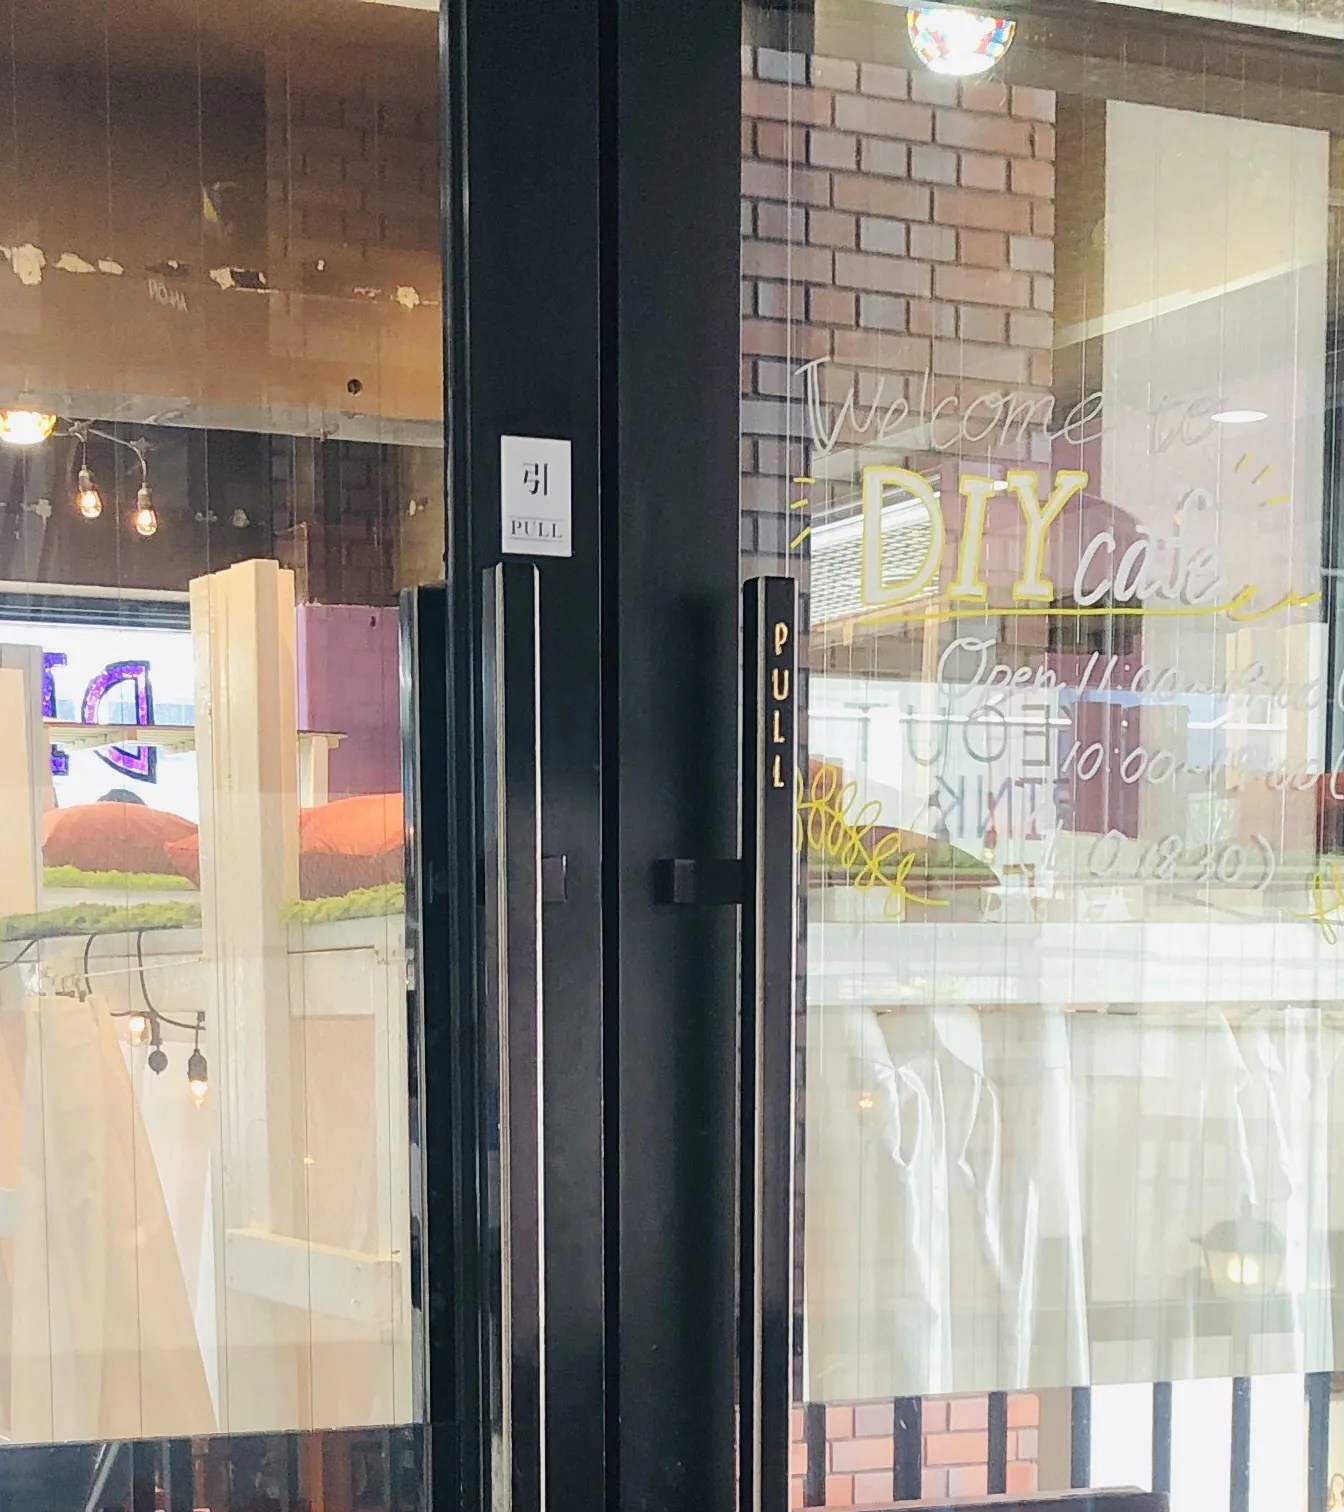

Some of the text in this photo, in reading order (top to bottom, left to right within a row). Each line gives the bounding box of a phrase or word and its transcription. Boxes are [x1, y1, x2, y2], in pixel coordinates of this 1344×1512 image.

[794, 356, 1105, 455] Welcome
[522, 462, 549, 496] 引
[511, 519, 563, 539] PULL
[861, 464, 1088, 606] DIY
[771, 622, 790, 789] PULL
[937, 636, 1067, 706] Open
